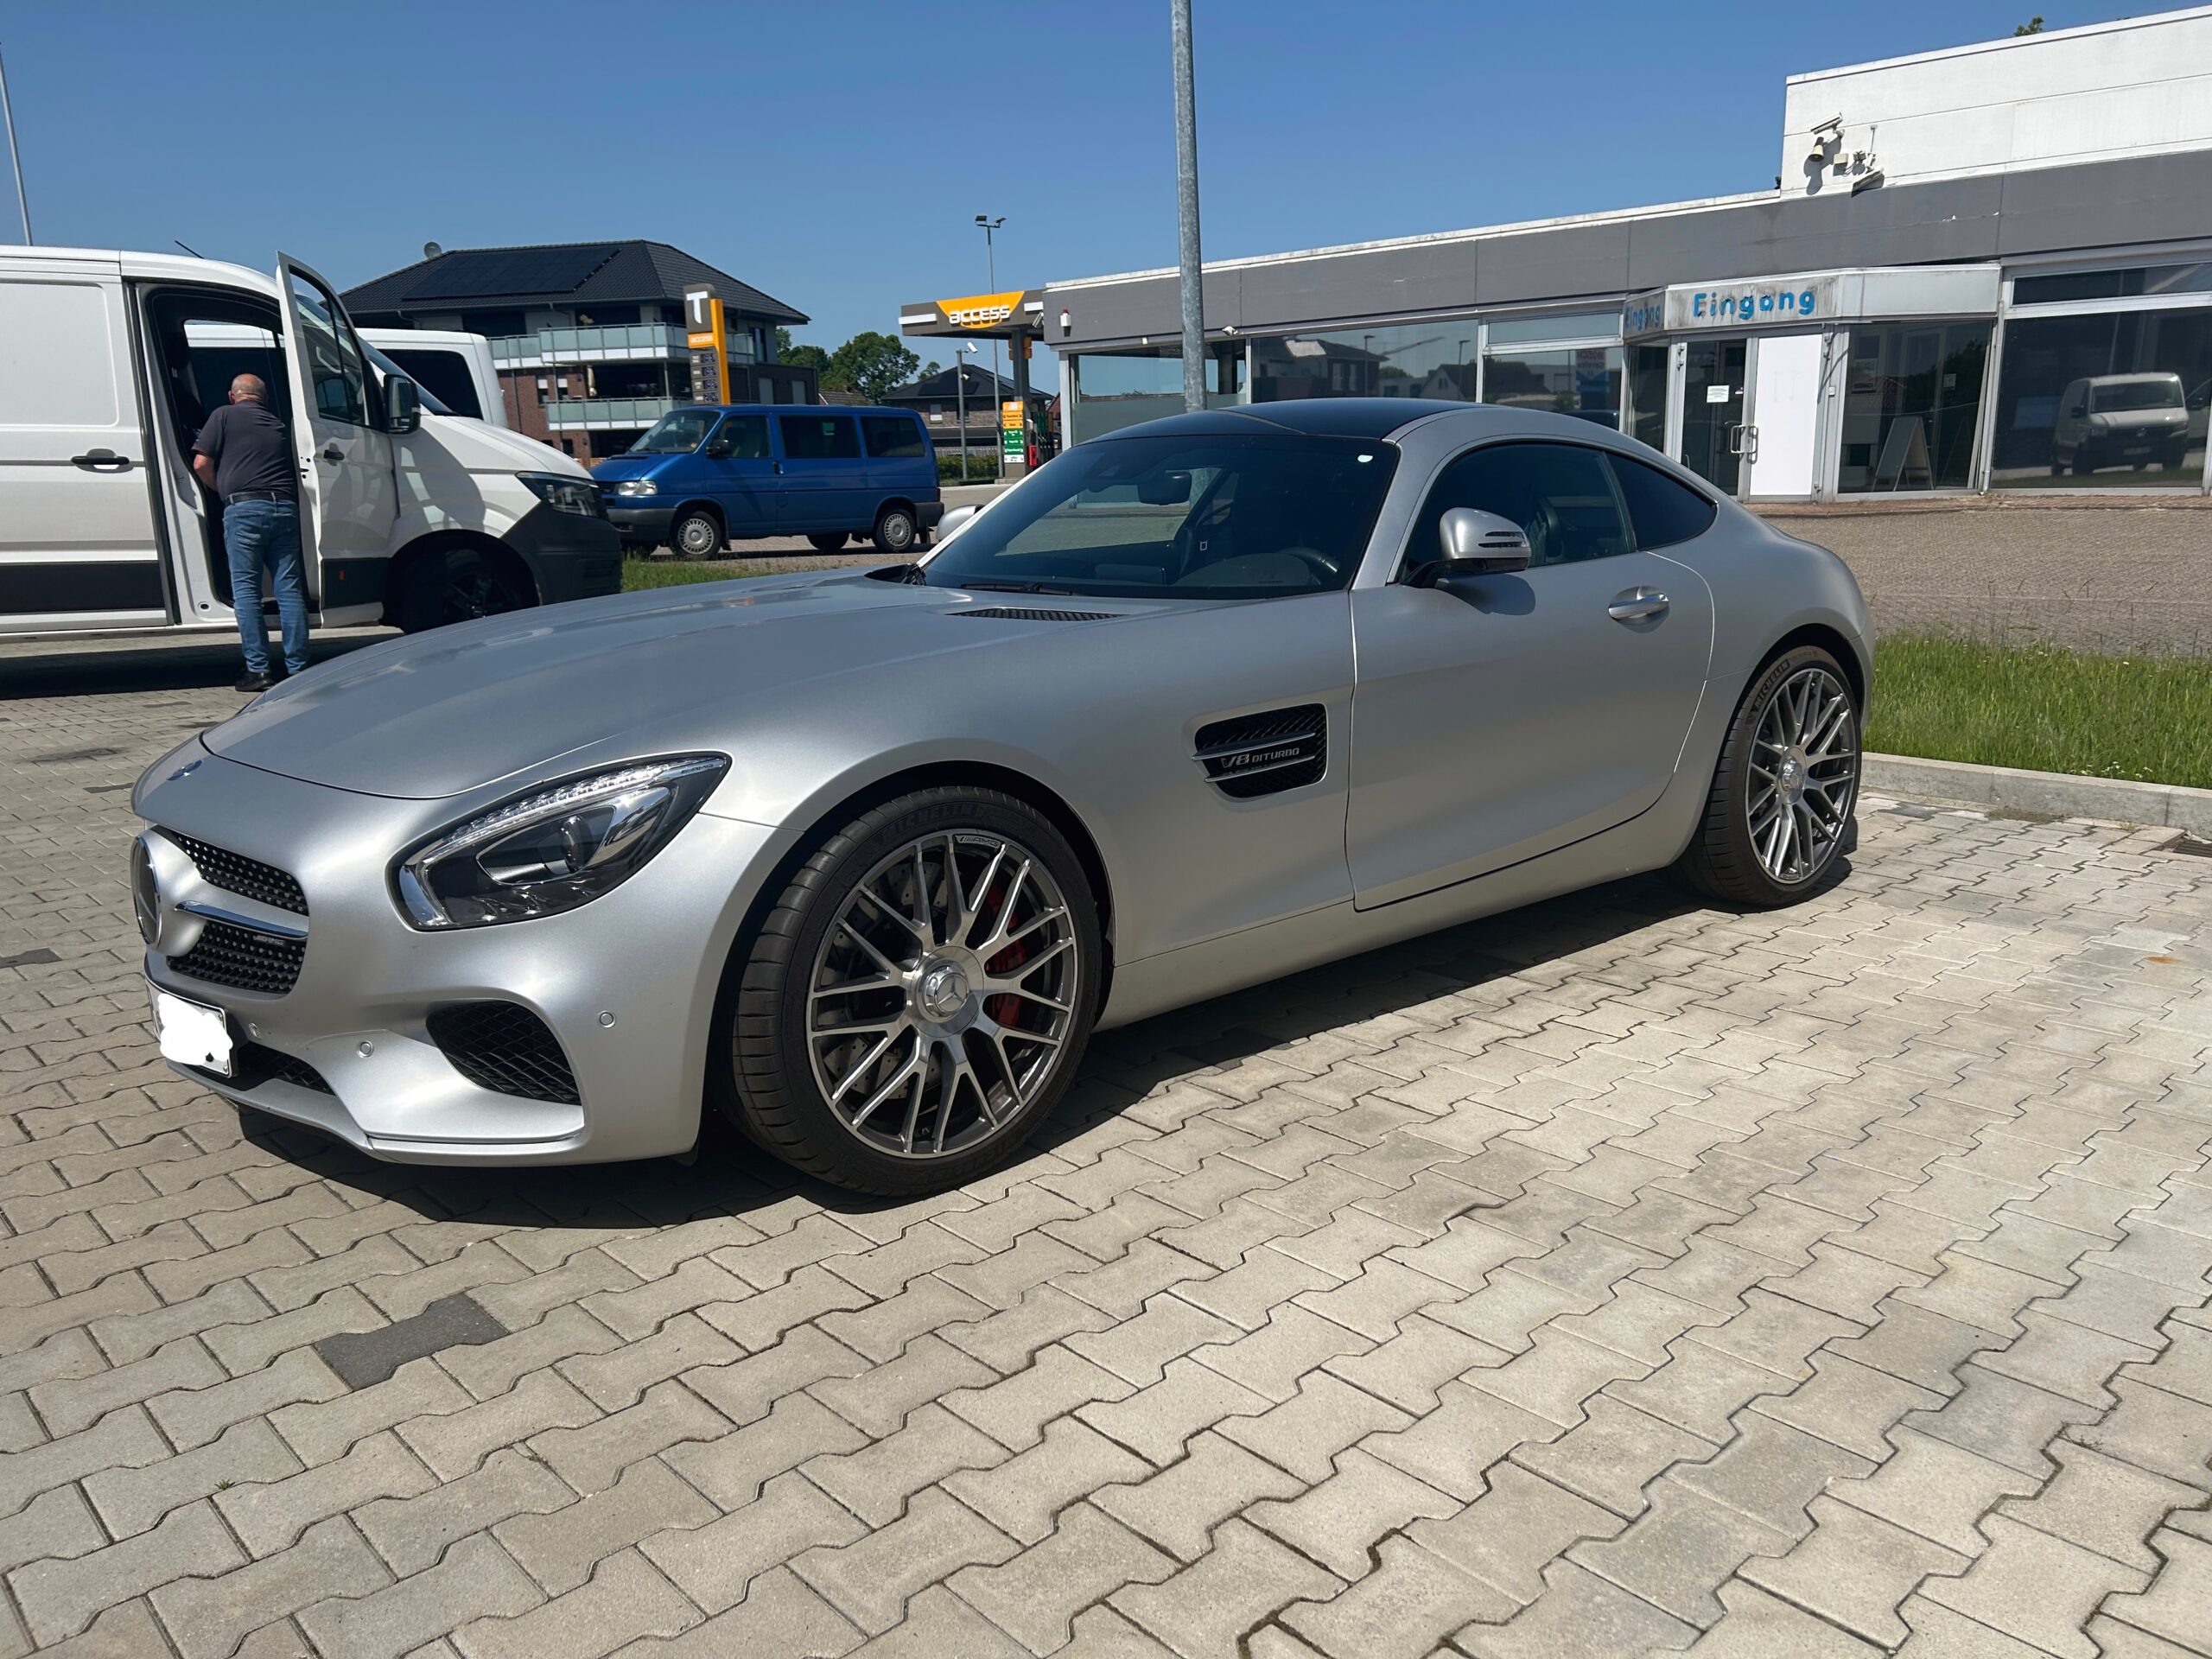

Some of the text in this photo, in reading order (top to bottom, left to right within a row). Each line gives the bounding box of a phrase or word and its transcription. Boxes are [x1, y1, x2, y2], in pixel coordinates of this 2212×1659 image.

[1694, 290, 1815, 320] Eingang
[1755, 659, 1790, 709] MICHELIN
[1221, 747, 1300, 768] V8 BITURBO
